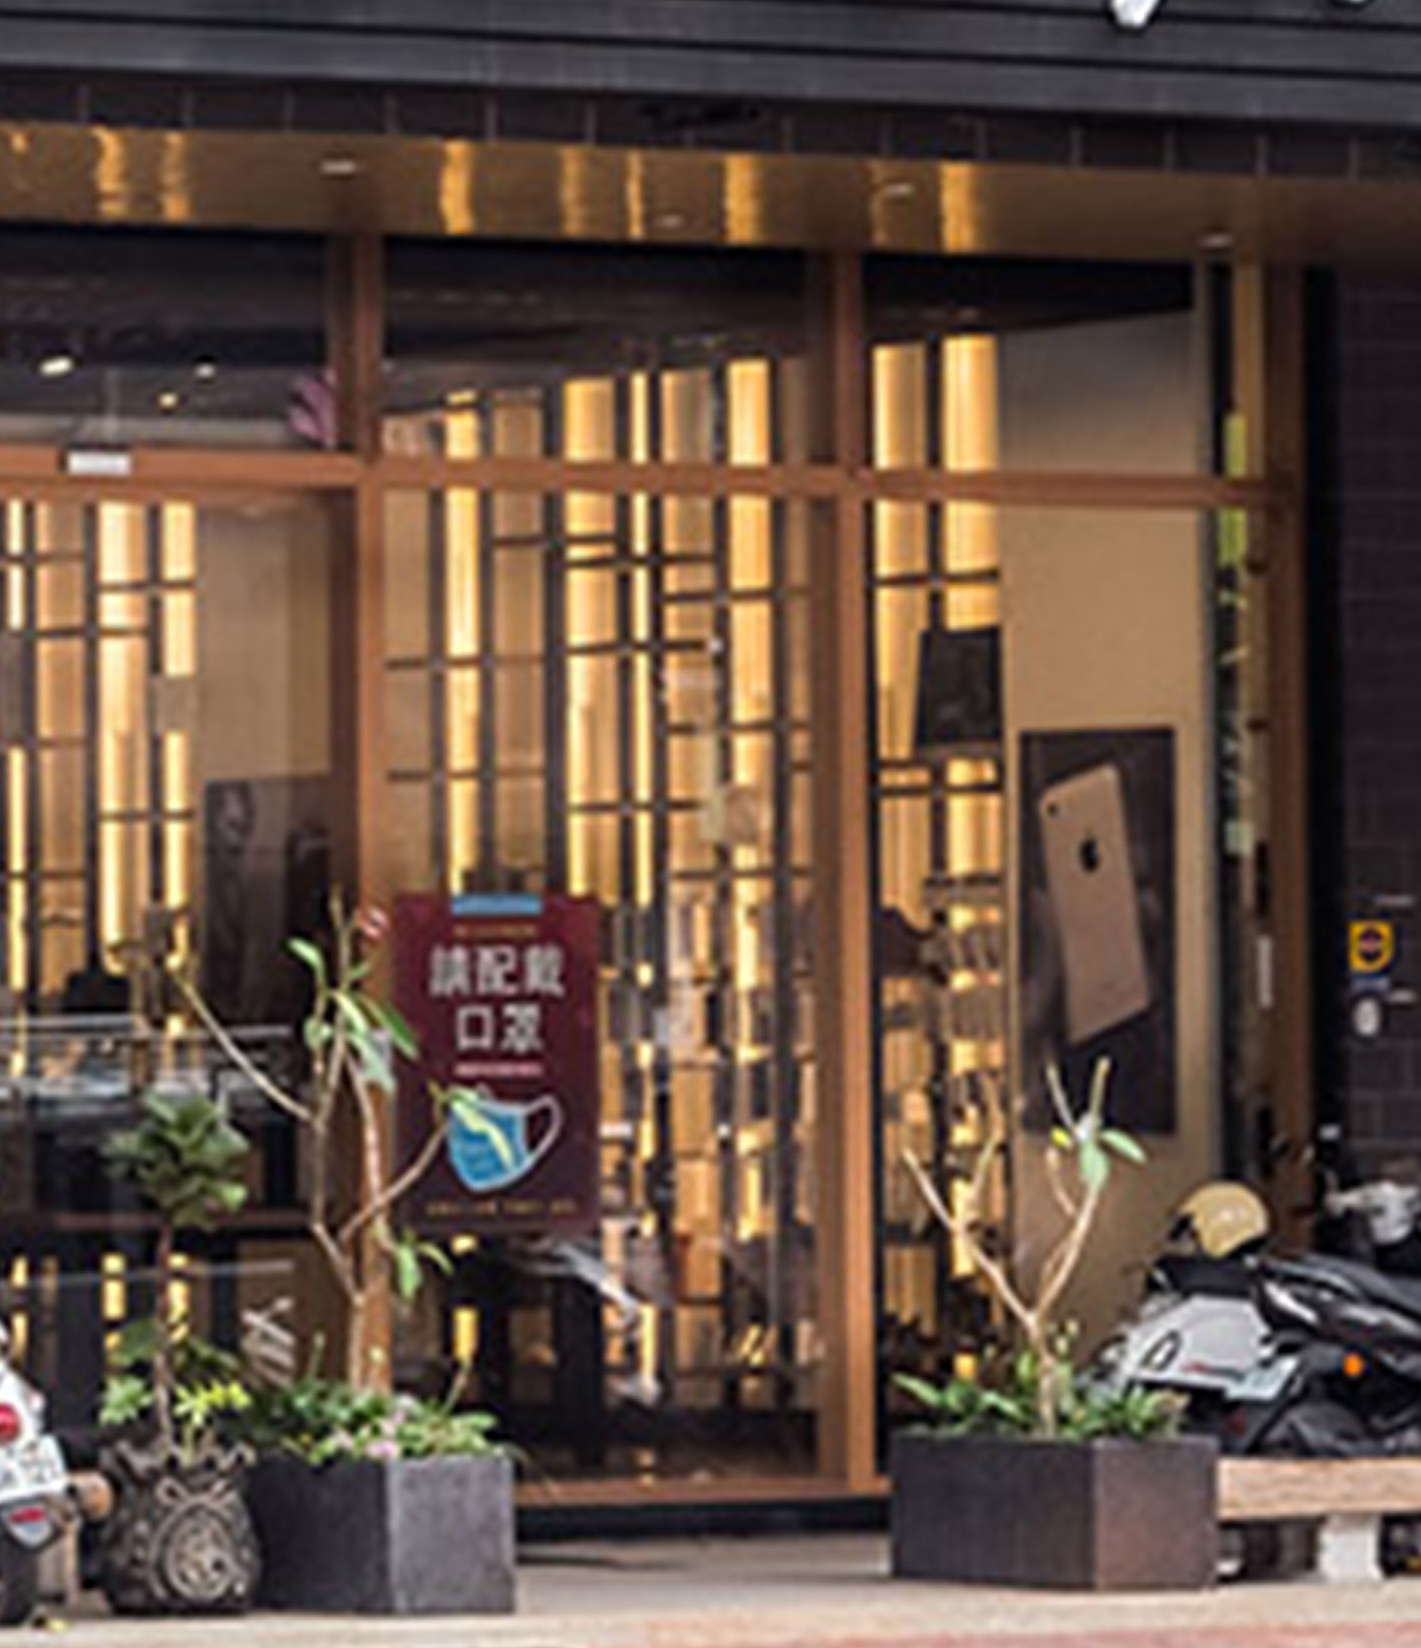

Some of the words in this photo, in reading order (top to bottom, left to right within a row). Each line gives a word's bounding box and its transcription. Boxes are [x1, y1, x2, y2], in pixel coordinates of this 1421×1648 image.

[429, 944, 566, 998] 請配戴
[455, 1003, 544, 1054] 口罩
